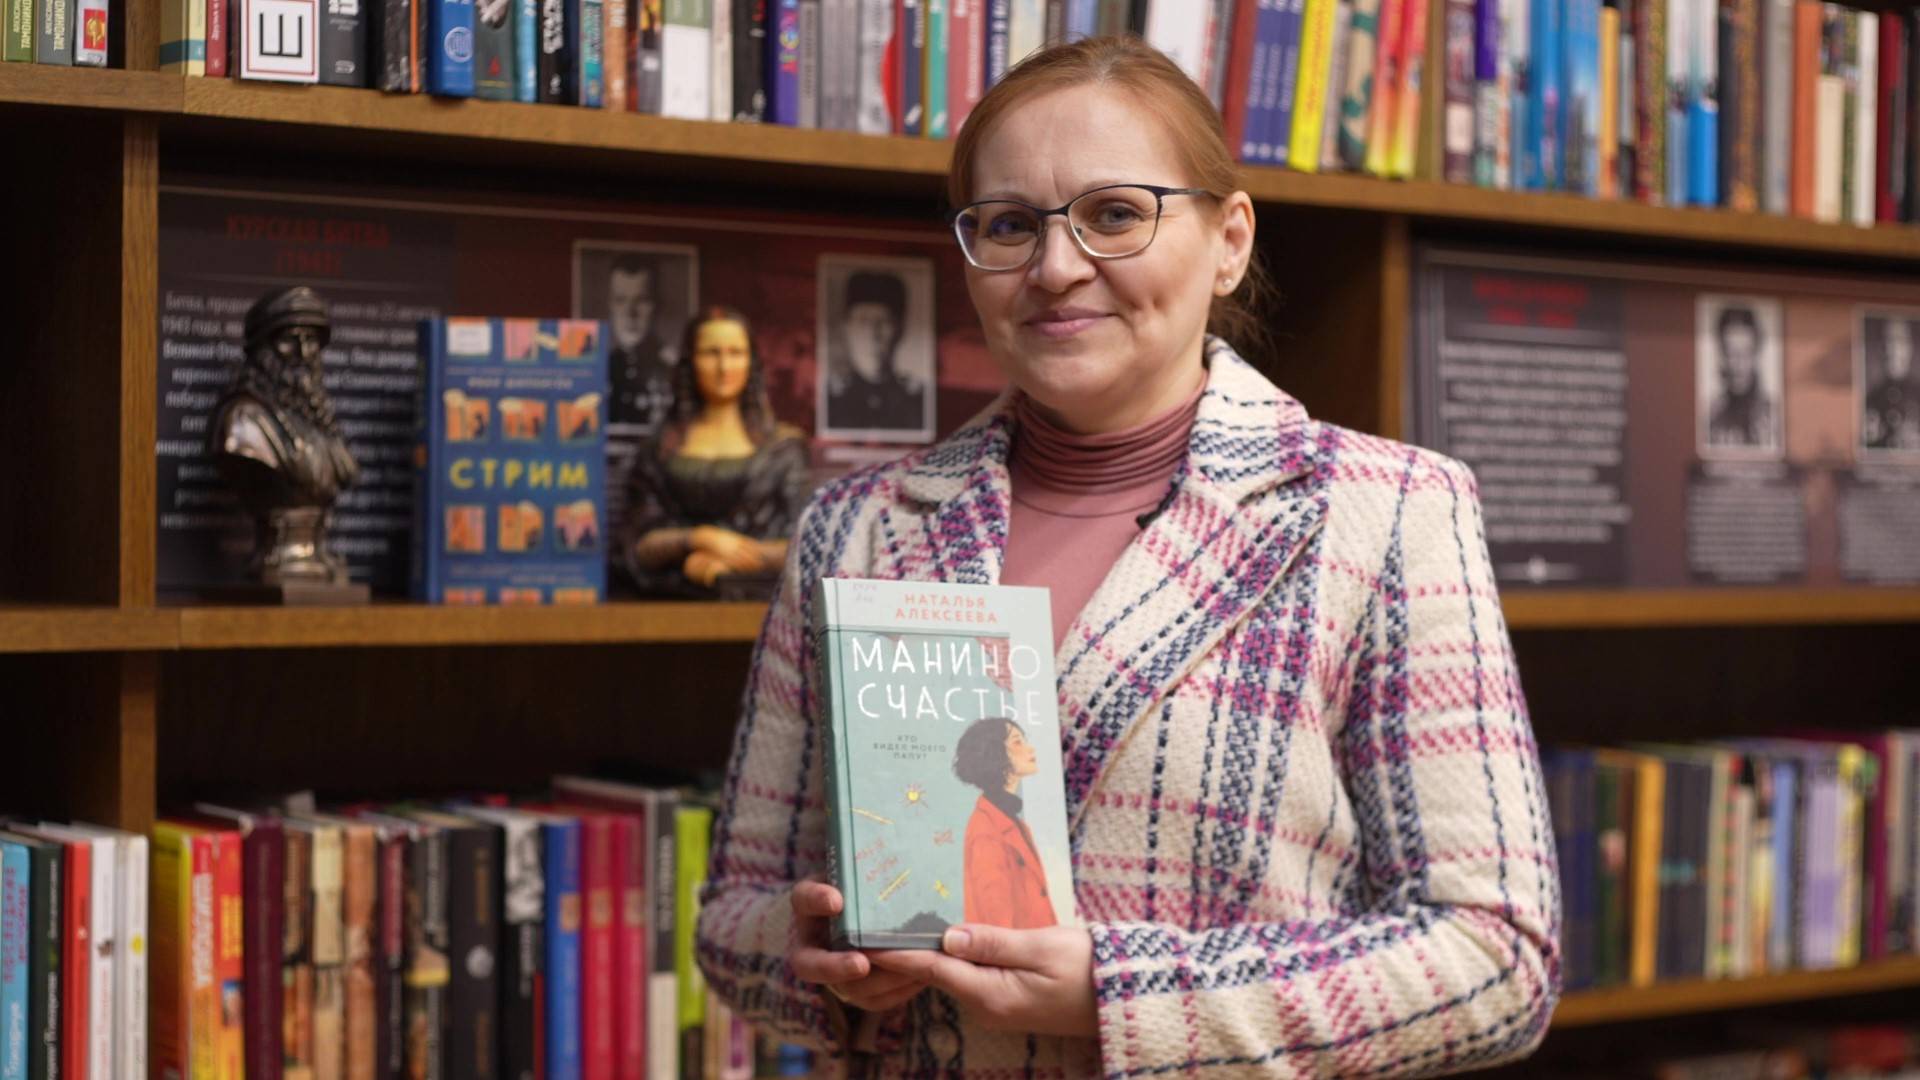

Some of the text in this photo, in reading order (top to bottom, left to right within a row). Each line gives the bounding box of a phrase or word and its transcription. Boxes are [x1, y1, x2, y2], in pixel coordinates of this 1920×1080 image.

[258, 12, 303, 58] Ш
[322, 218, 391, 248] БИТВА
[450, 458, 588, 489] СТРИМ
[904, 593, 986, 609] НАТАЛЬЯ
[895, 608, 999, 624] АЛЕКСЕЕВА
[852, 637, 1041, 680] МАНИНО
[857, 682, 1042, 726] СЧАСТЬЕ
[873, 742, 947, 753] ВИДЕЛ МОЕГО
[897, 735, 918, 743] КТО
[893, 752, 928, 761] ПАПУ?
